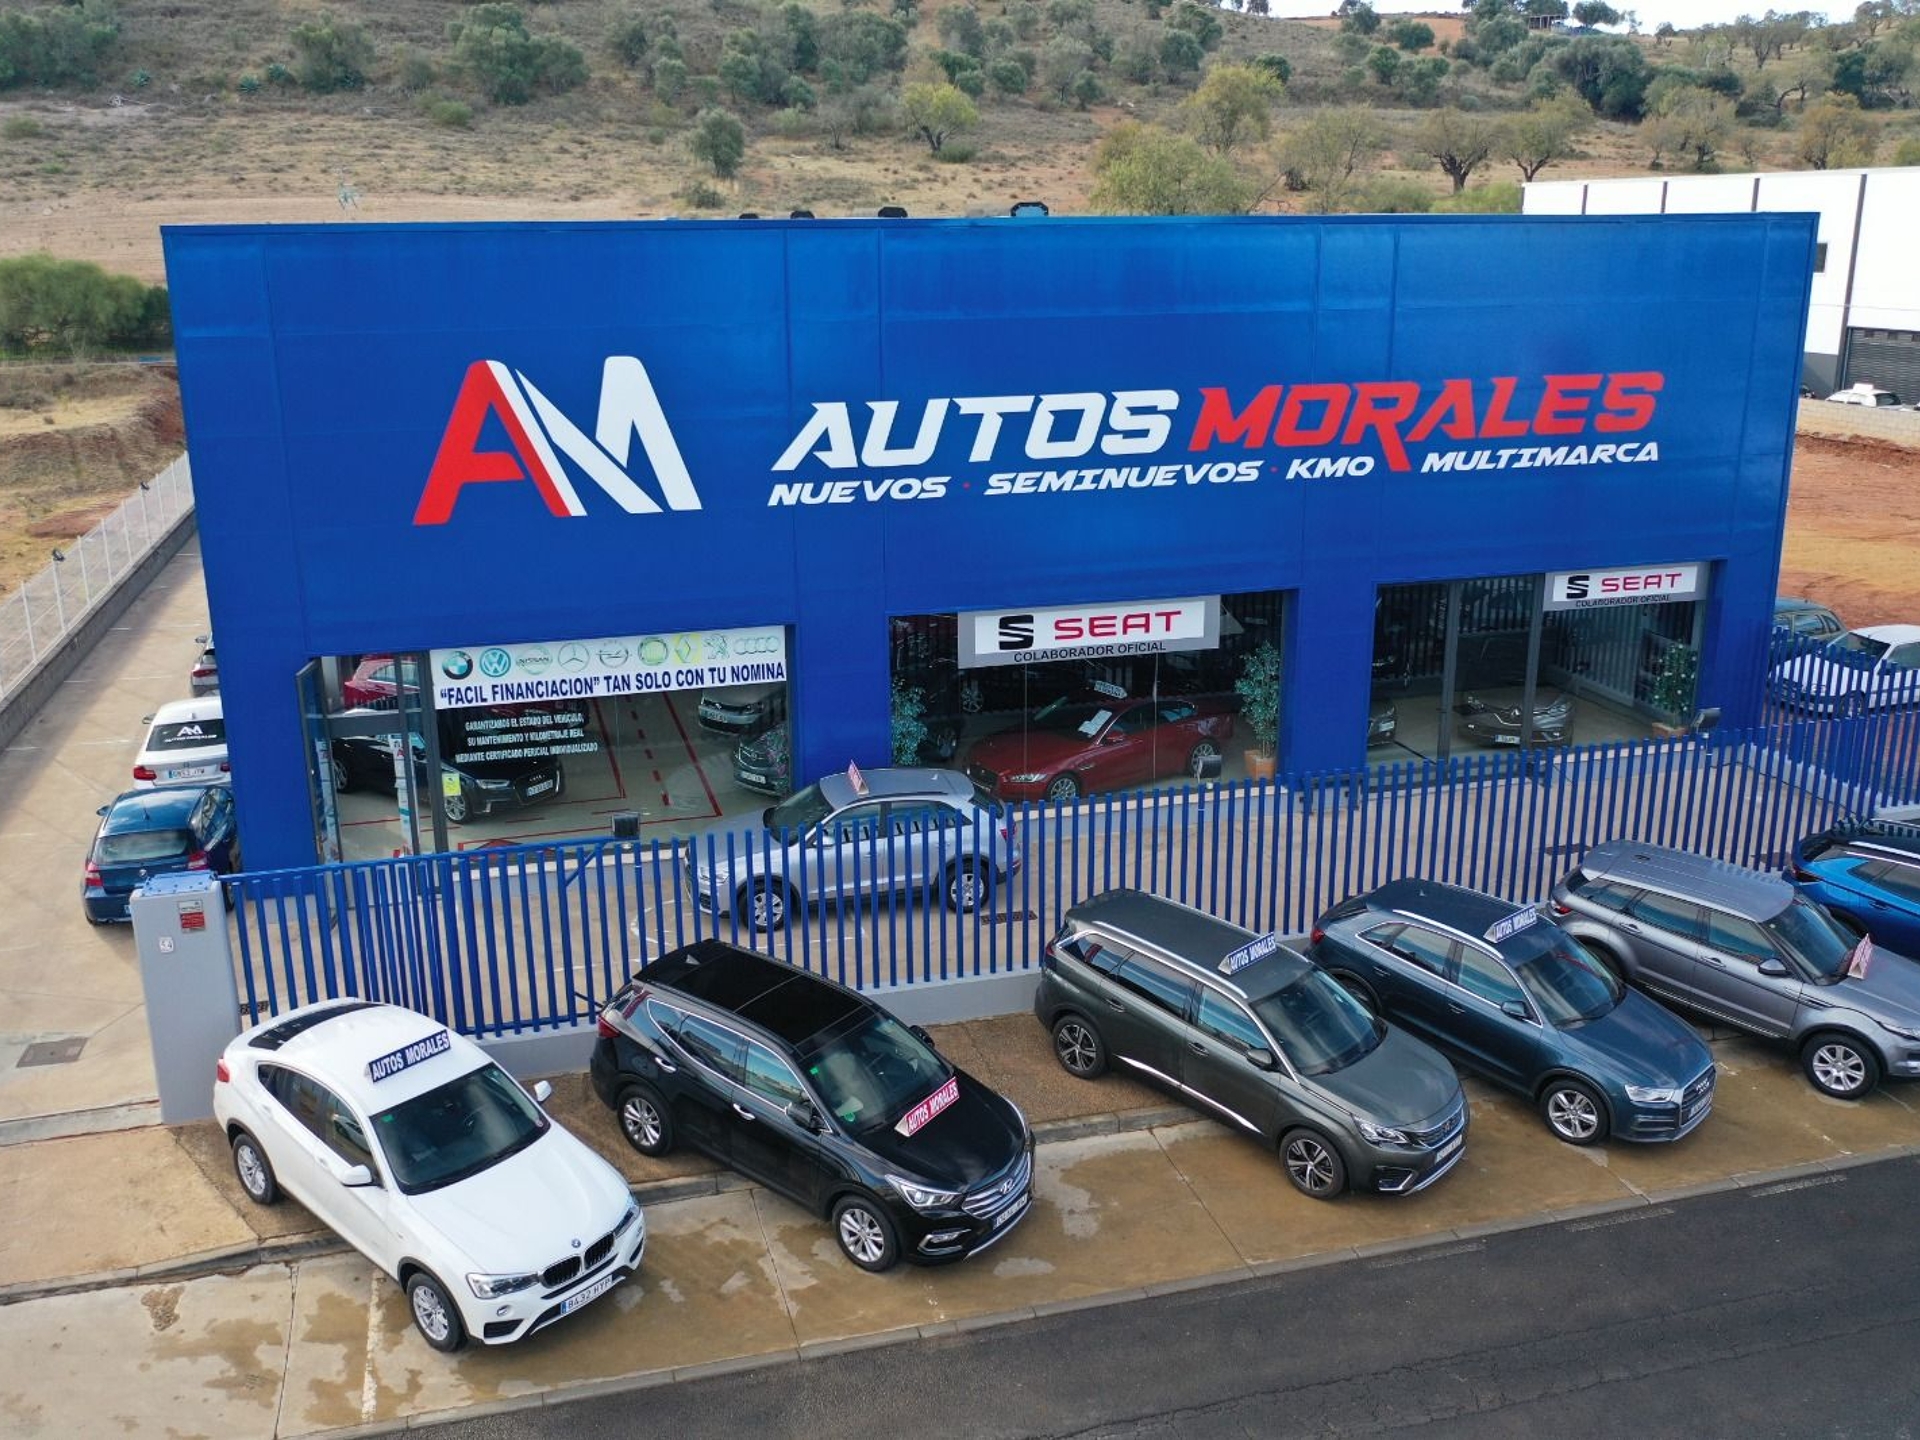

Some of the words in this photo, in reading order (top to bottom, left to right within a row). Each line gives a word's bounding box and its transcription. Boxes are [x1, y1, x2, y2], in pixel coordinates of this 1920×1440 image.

[771, 389, 1180, 471] AUTOS
[1188, 371, 1665, 472] MORALES
[413, 355, 703, 525] AM
[768, 476, 952, 507] NUEVOS
[984, 460, 1265, 496] SEMINUEVOS
[1421, 442, 1659, 473] MULTIMARCA
[1601, 573, 1682, 593] SEAT
[1054, 610, 1182, 640] SEAT
[1014, 643, 1114, 663] COLABORADOR
[1117, 641, 1167, 655] OFICIAL
[604, 674, 631, 693] TAN
[635, 671, 671, 690] SOLO
[676, 668, 705, 687] CON
[708, 666, 727, 684] TU
[731, 662, 785, 683] NOMINA
[511, 718, 518, 728] EL
[519, 715, 541, 727] ESTADO
[542, 715, 553, 725] DEL
[467, 737, 476, 747] SU
[524, 733, 529, 742] Y
[455, 752, 486, 763] MEDIANTE
[486, 748, 523, 761] CERTIFICADO
[372, 1052, 405, 1081] AUTOS
[405, 1032, 450, 1065] MORALES
[908, 1104, 929, 1131] AUTOS
[929, 1081, 958, 1115] MORALES
